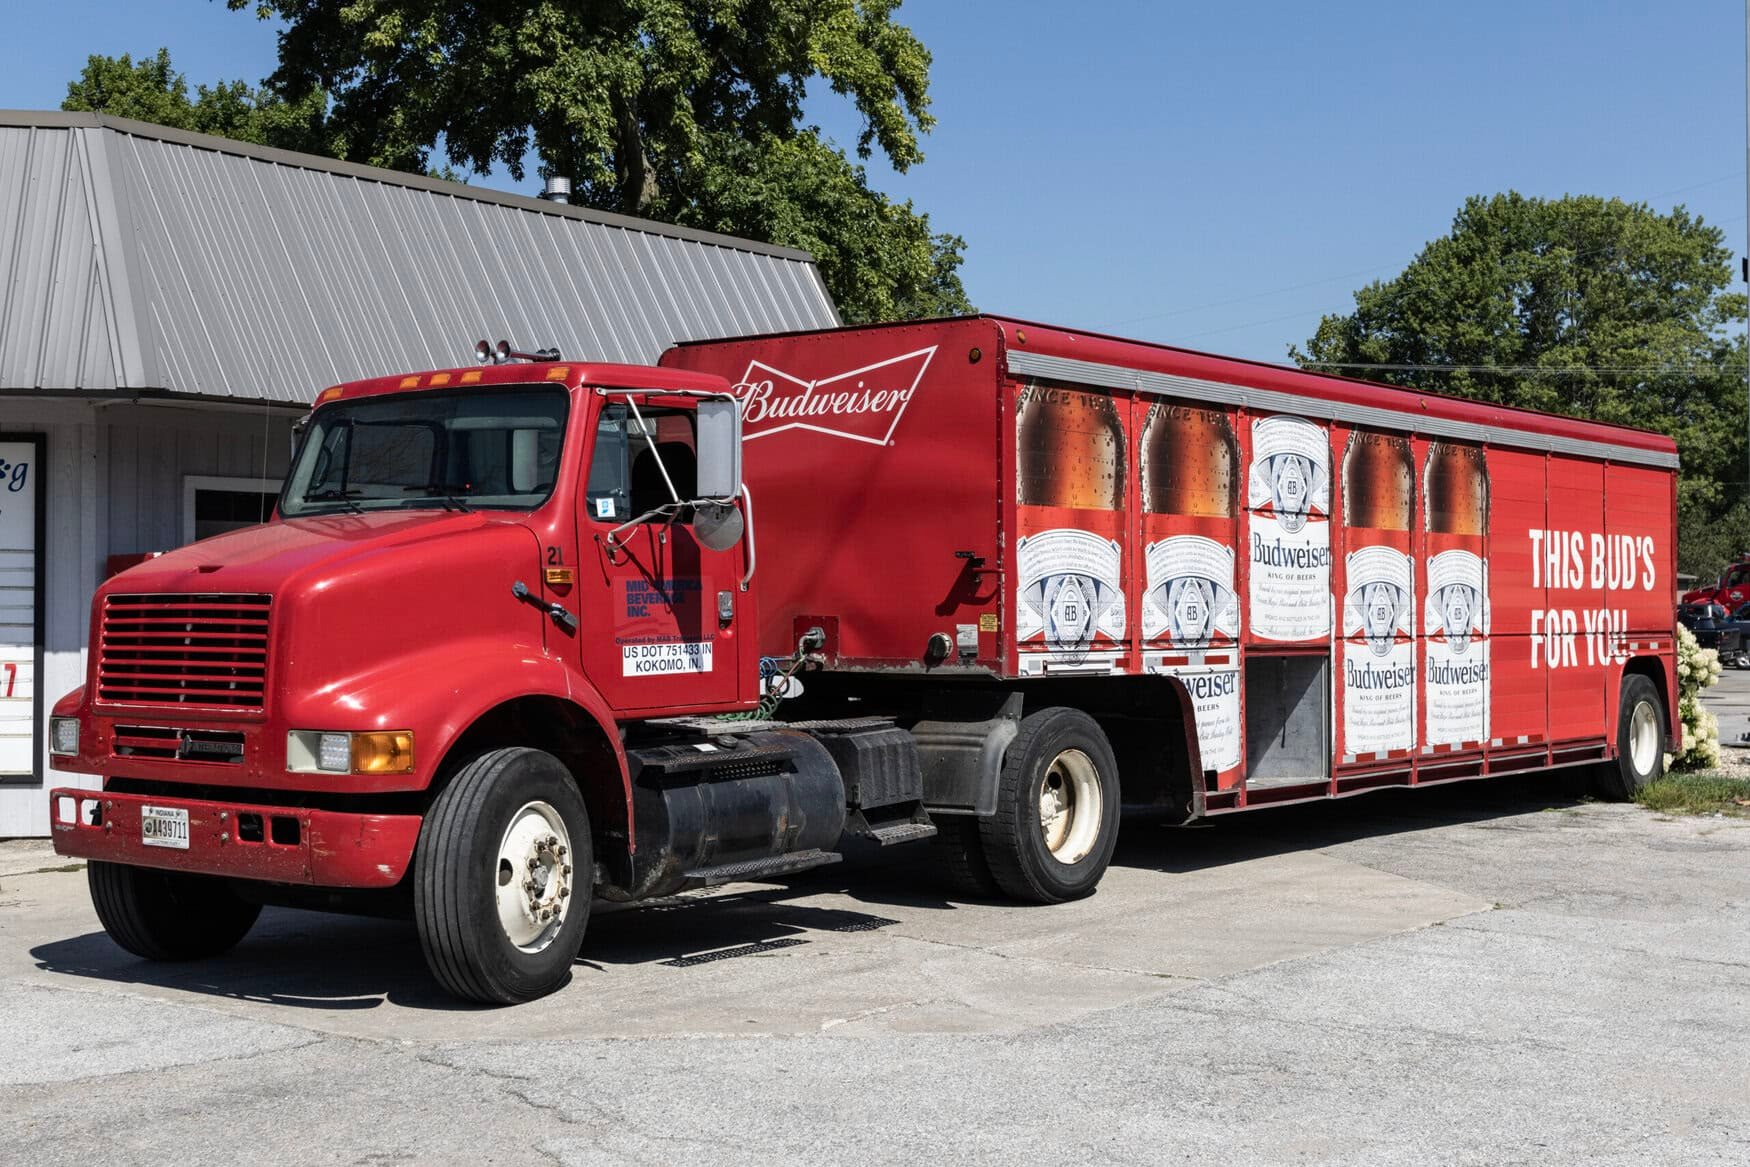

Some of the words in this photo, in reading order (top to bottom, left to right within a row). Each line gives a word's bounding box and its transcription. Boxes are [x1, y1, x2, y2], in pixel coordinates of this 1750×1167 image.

[731, 379, 909, 423] Budweiser
[547, 546, 564, 566] 21
[1253, 531, 1330, 569] Budweiser
[1529, 529, 1584, 590] THIS
[1590, 533, 1656, 591] BUD'S
[626, 580, 649, 592] MID
[1267, 572, 1284, 580] KING
[1285, 573, 1294, 581] OF
[1296, 573, 1317, 581] BEERS
[627, 605, 651, 617] INC.
[1531, 609, 1578, 669] FOR
[623, 646, 639, 659] US
[641, 645, 664, 658] DOT
[666, 643, 700, 657] 751433
[702, 643, 712, 655] IN
[1347, 658, 1416, 690] Budweiser
[1180, 673, 1236, 699] weiser
[1197, 703, 1220, 713] BEERS
[153, 818, 187, 840] A439711
